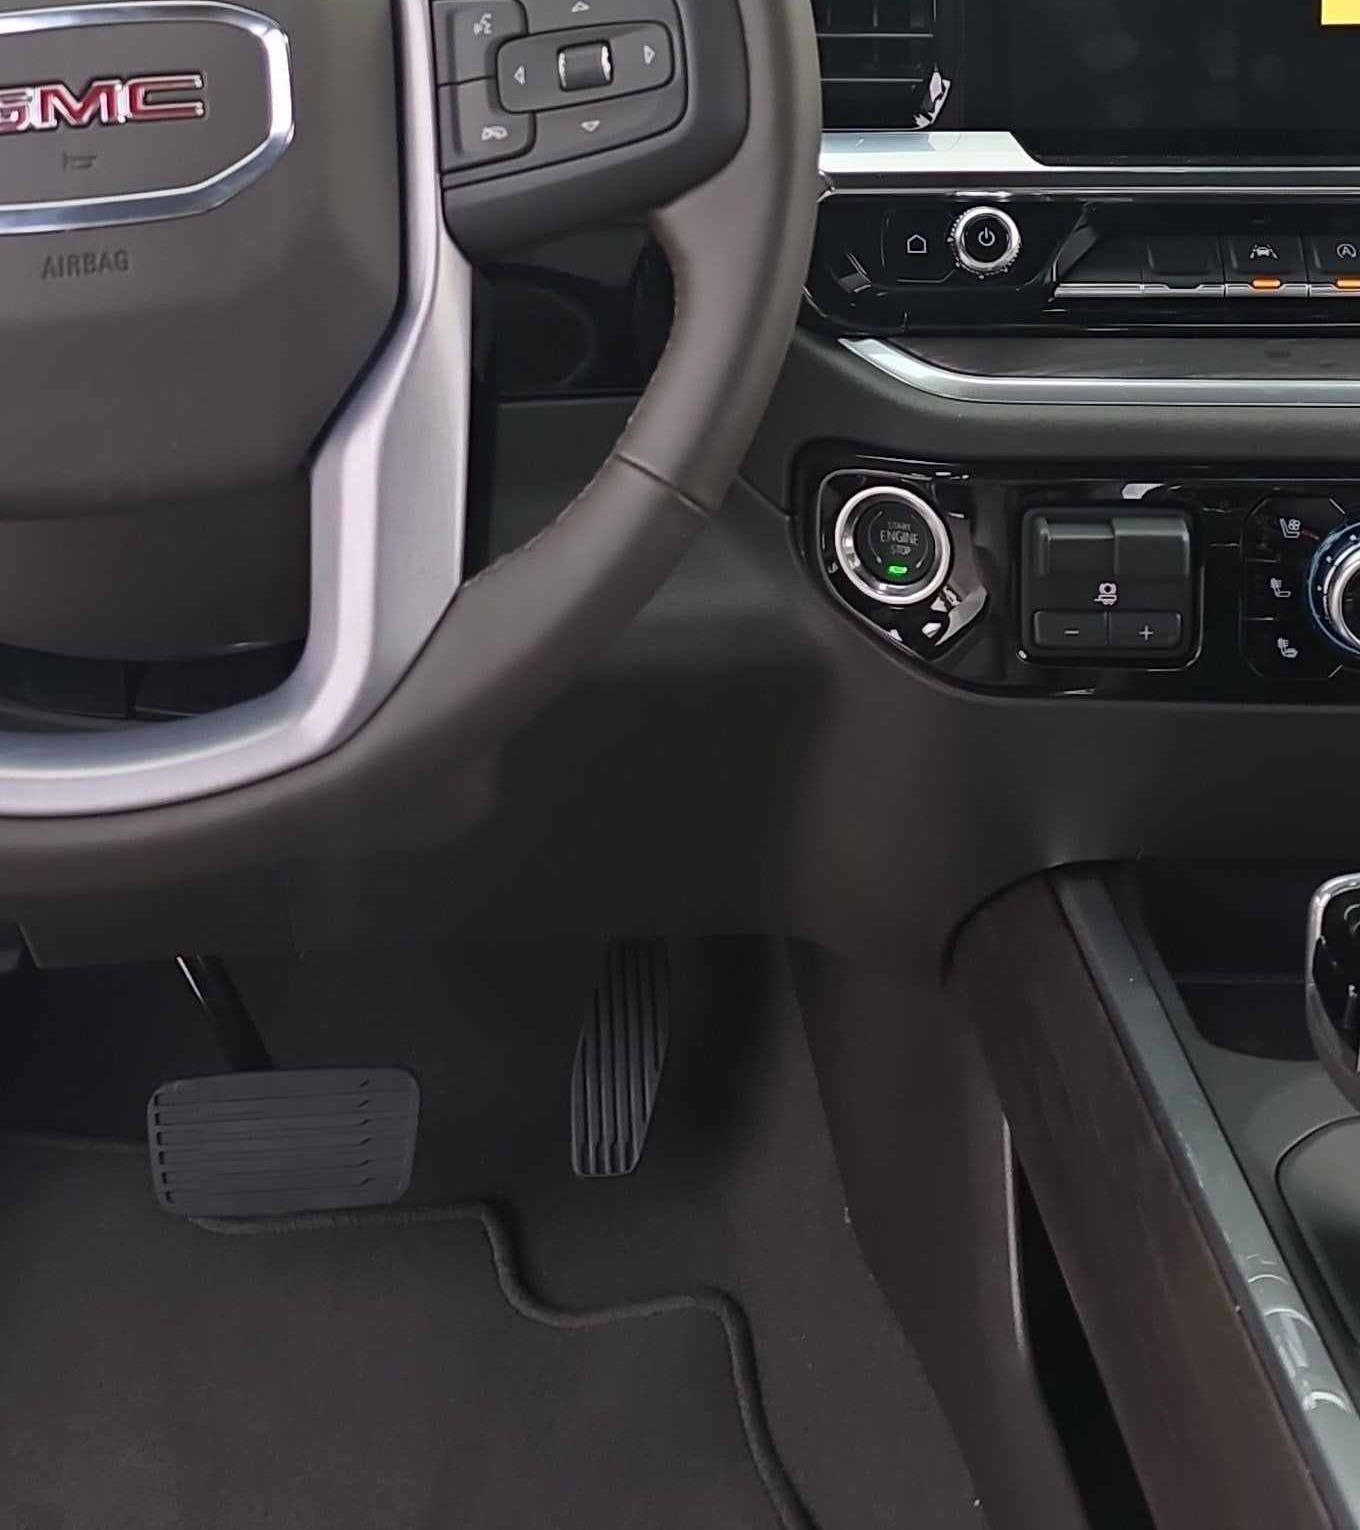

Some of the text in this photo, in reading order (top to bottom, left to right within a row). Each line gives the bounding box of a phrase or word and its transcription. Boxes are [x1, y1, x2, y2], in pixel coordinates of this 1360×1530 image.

[41, 250, 129, 280] AIRBAG
[887, 521, 911, 531] START
[880, 530, 919, 546] ENGINE
[890, 545, 911, 556] STOP
